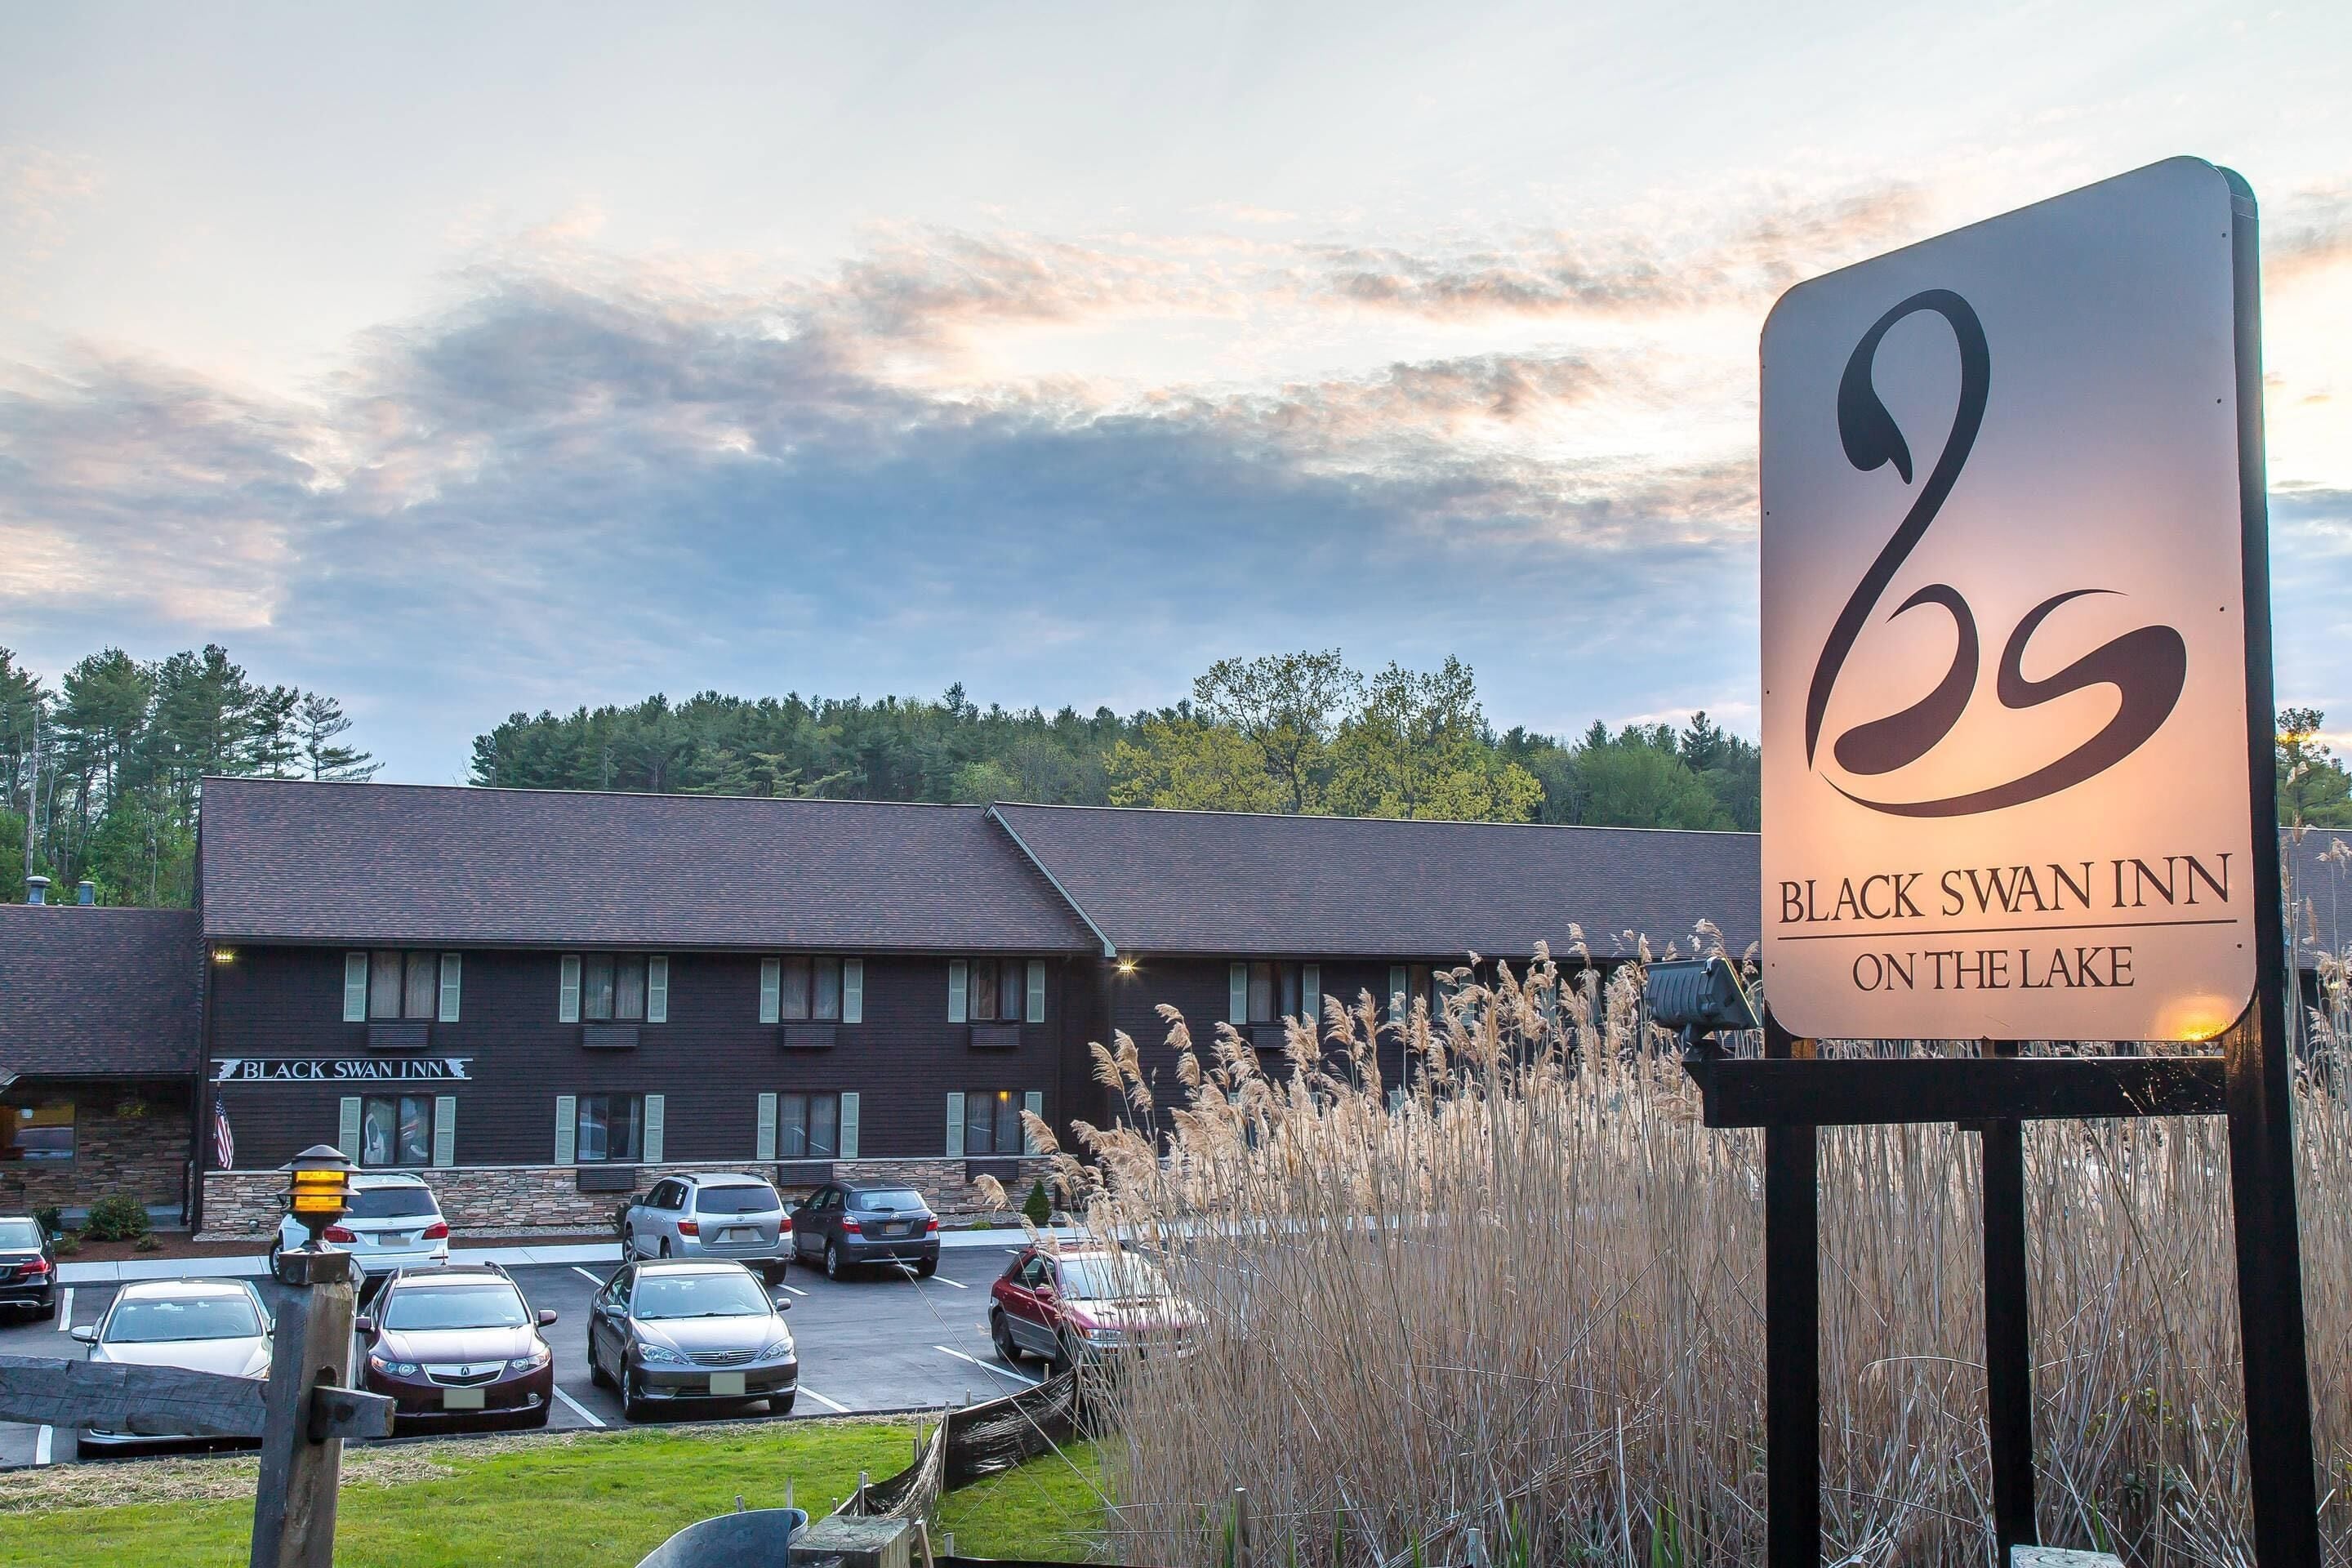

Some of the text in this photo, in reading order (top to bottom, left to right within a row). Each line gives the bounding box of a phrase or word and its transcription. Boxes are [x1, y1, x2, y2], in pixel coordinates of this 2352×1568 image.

[1778, 853, 2234, 924] BLACK SWAN INN
[1852, 946, 2136, 991] ON THE LAKE
[243, 1060, 443, 1079] BLACK SWAN INN
